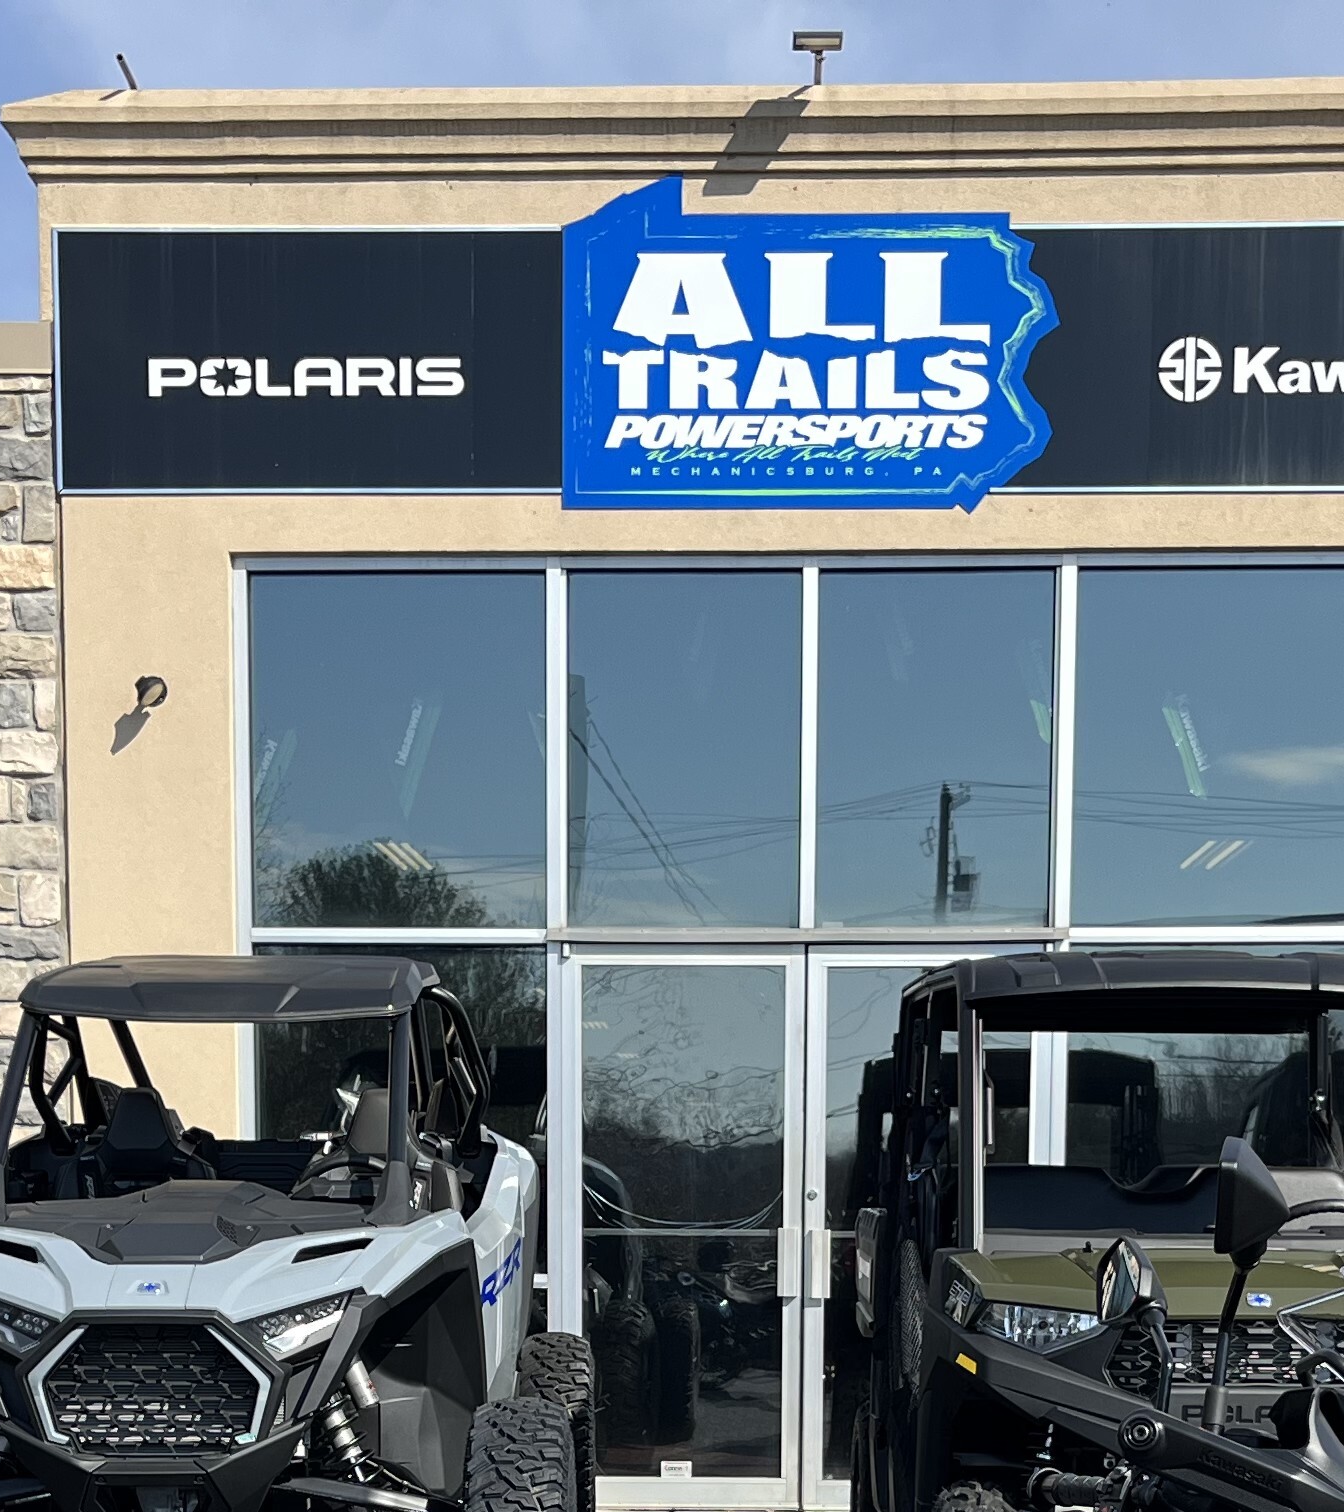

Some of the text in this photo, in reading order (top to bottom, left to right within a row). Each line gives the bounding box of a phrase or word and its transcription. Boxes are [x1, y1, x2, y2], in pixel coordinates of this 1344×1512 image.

[612, 250, 991, 349] ALL
[148, 357, 465, 397] POLARIS
[602, 348, 991, 410] TRAILS
[604, 414, 988, 450] POWERSPORTS
[645, 444, 926, 464] Where All Trails Meet
[914, 467, 943, 476] PA
[480, 1237, 522, 1307] RZR
